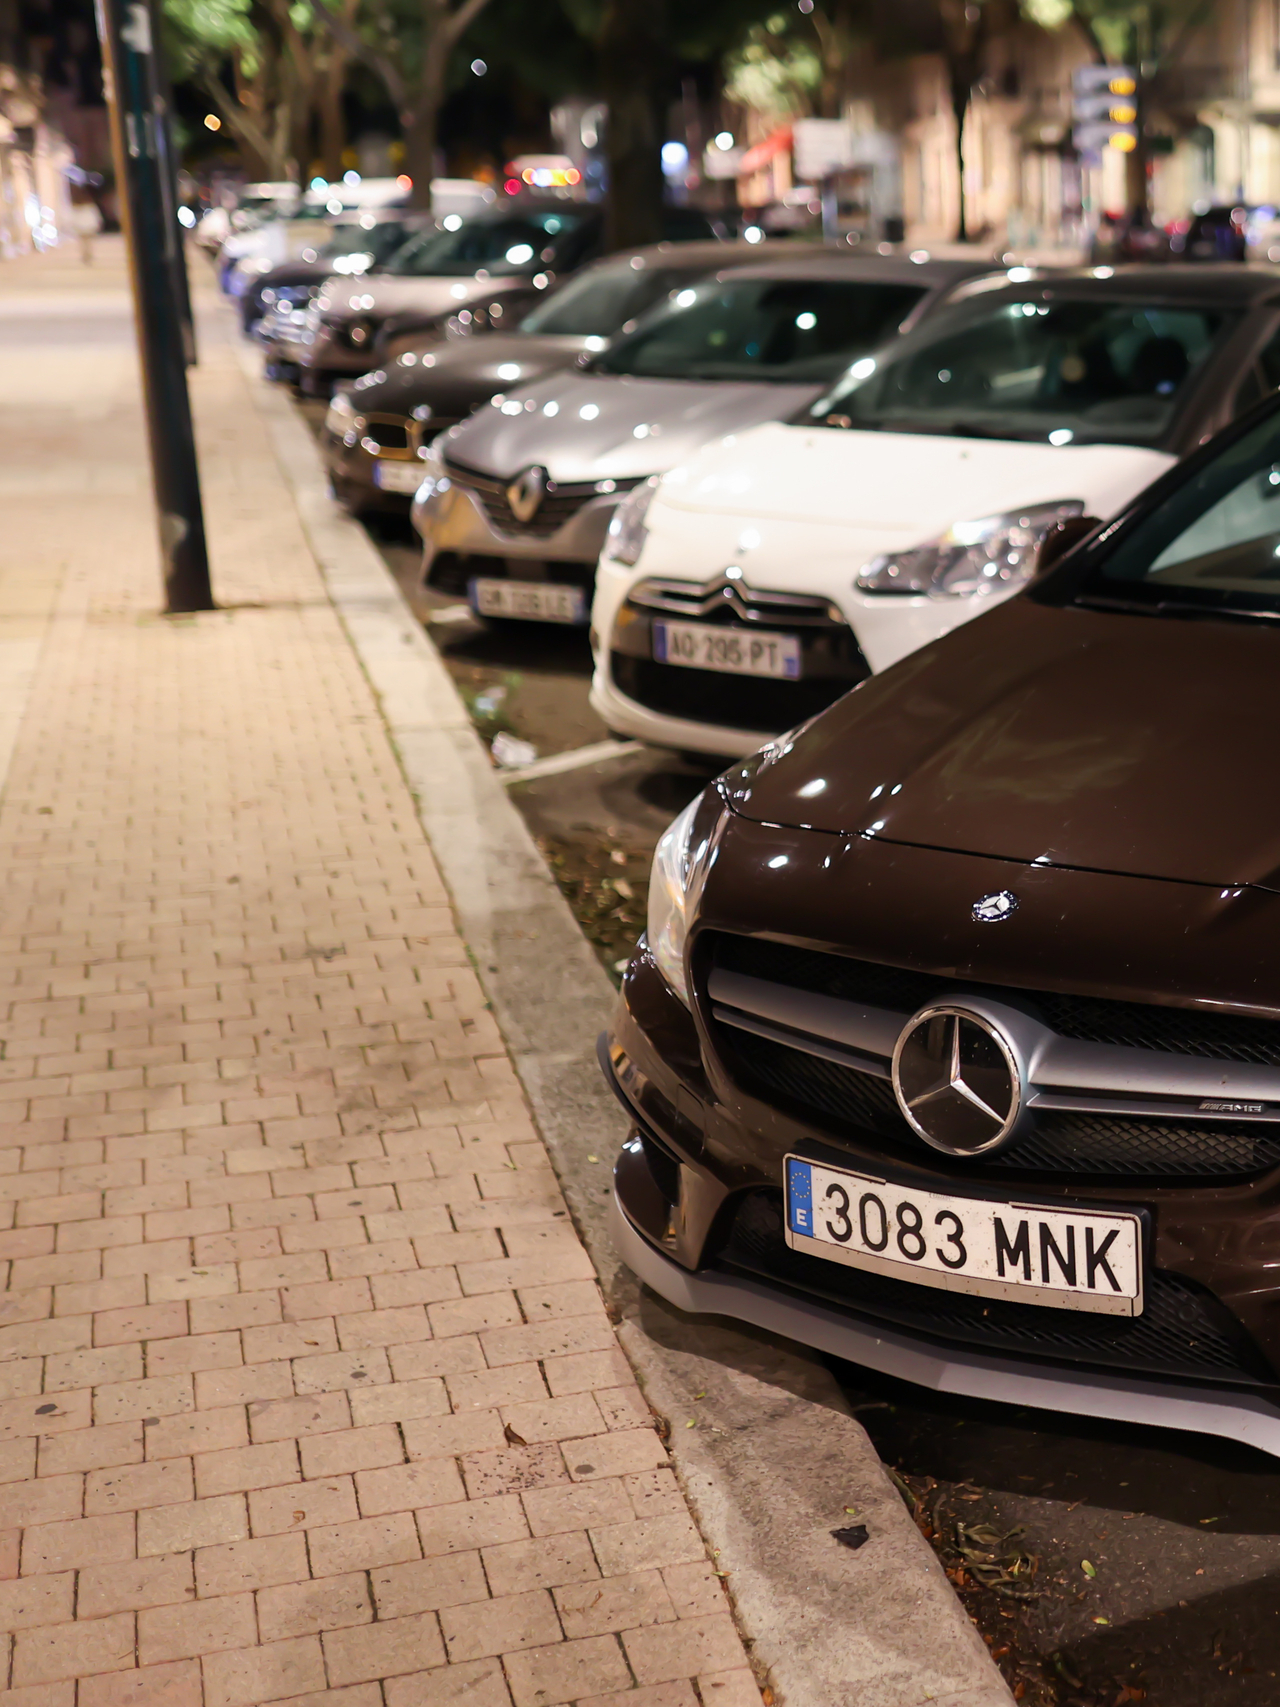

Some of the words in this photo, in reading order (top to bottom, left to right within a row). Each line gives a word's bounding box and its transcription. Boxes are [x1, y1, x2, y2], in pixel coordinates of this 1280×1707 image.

[751, 641, 778, 670] PT
[1221, 1103, 1262, 1113] AMG
[795, 1207, 808, 1227] E
[825, 1183, 968, 1270] 3083
[993, 1217, 1123, 1293] MNK
